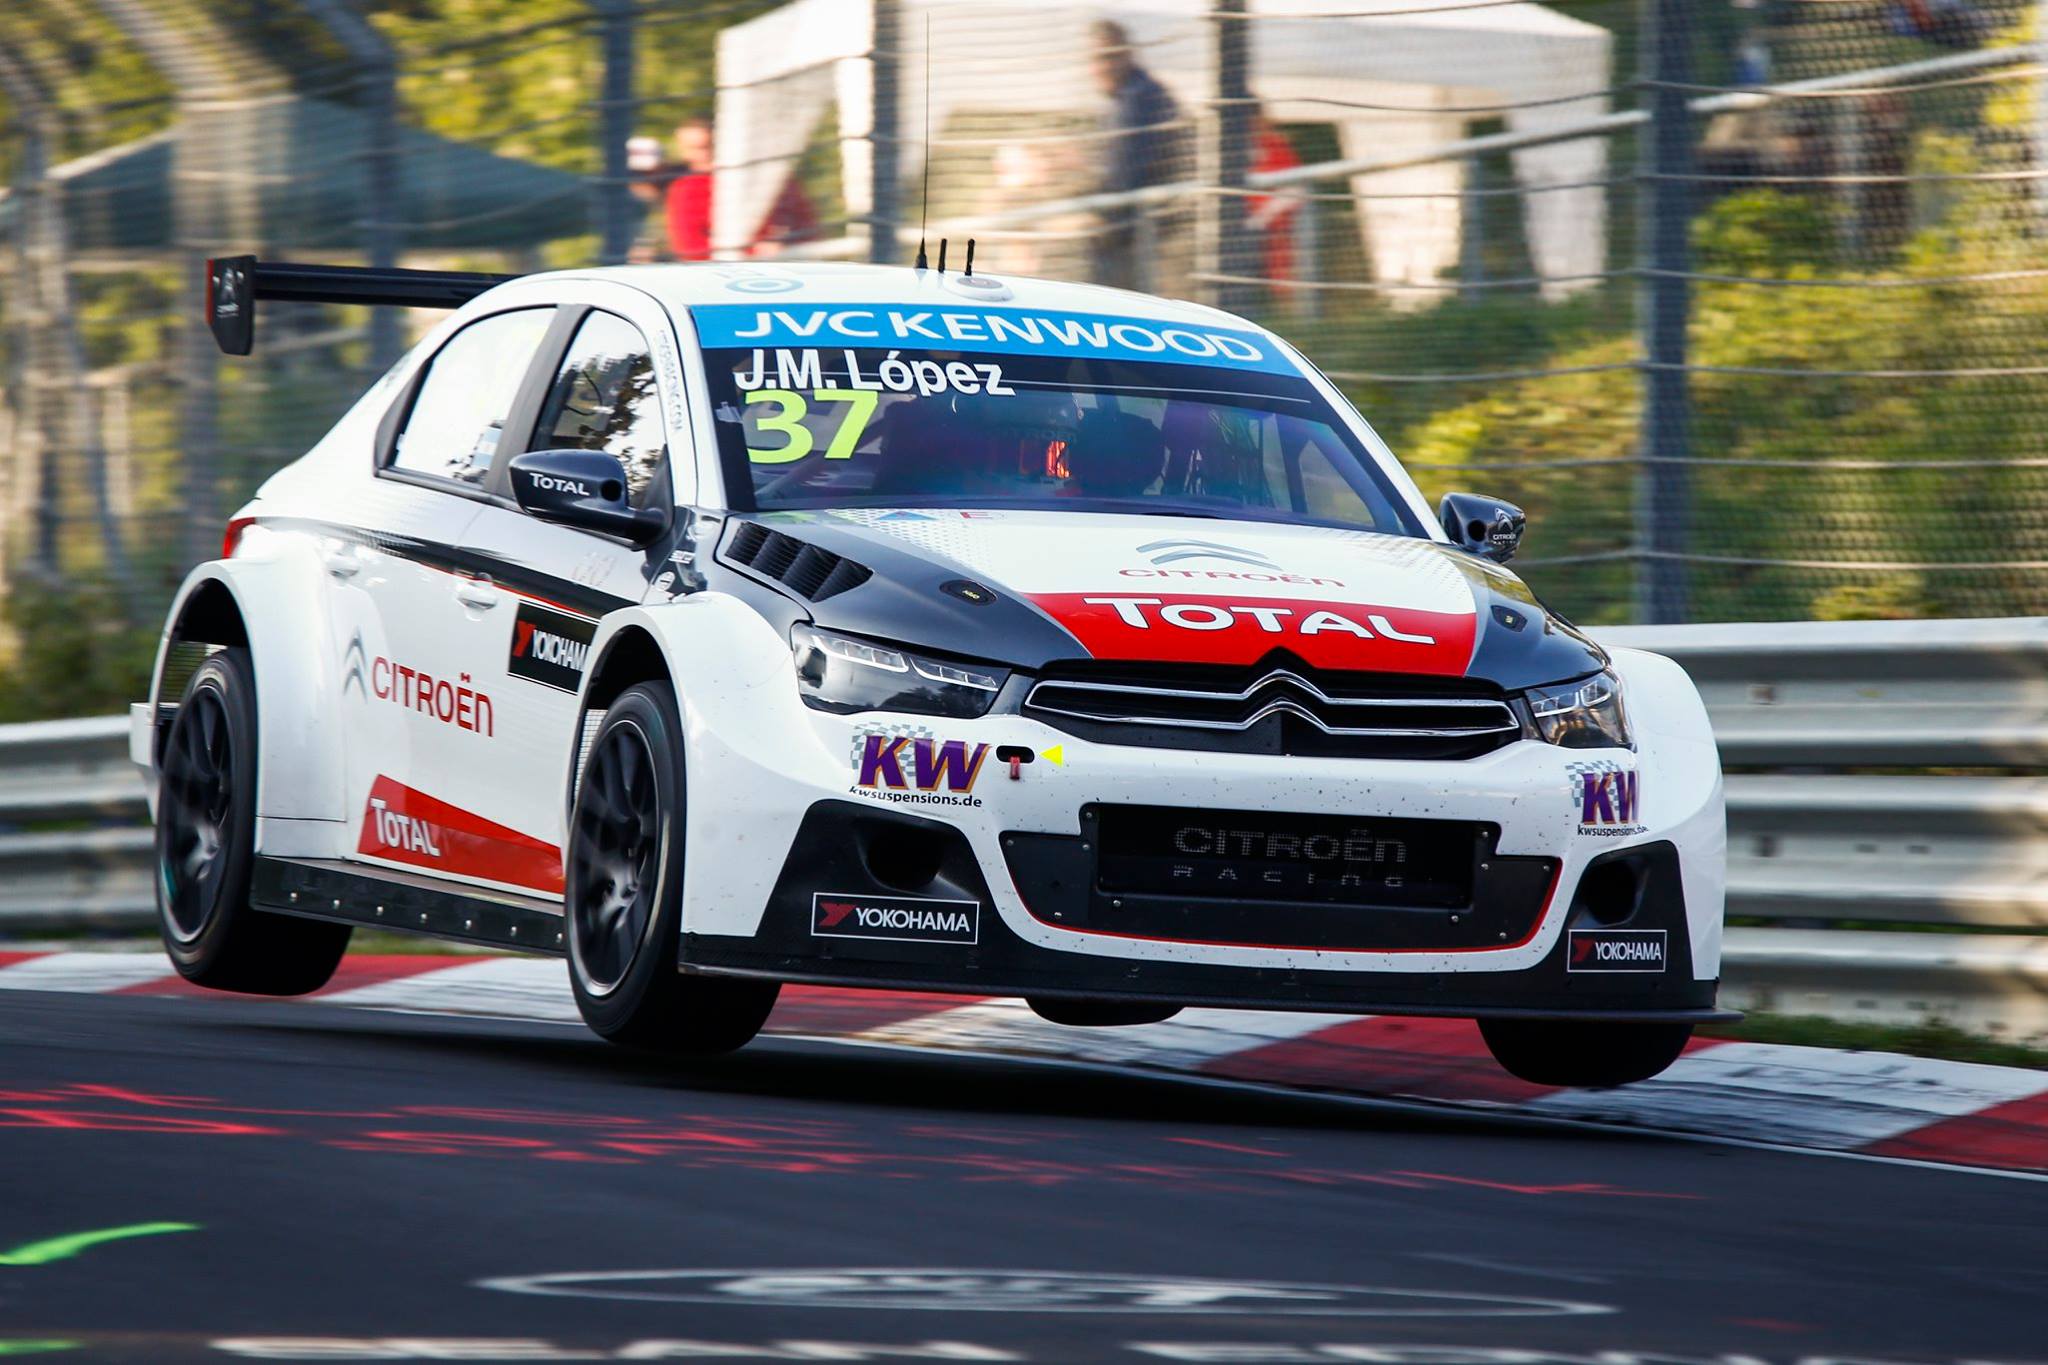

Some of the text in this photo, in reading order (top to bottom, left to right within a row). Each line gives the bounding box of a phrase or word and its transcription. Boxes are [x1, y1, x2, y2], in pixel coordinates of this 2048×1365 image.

[734, 348, 837, 390] J.M.
[843, 350, 1016, 397] López
[746, 388, 879, 464] 37
[529, 472, 590, 496] TOTAL
[1083, 596, 1436, 645] TOTAL
[532, 629, 592, 672] YOKOHAM
[372, 655, 493, 738] CITROËN
[858, 735, 992, 793] KW
[850, 786, 982, 807] kwsuspensions.de
[1582, 770, 1640, 825] KW
[371, 797, 440, 857] TOTAL
[856, 907, 970, 932] YOKOHAMA
[1595, 942, 1663, 961] YOKOHAMA
